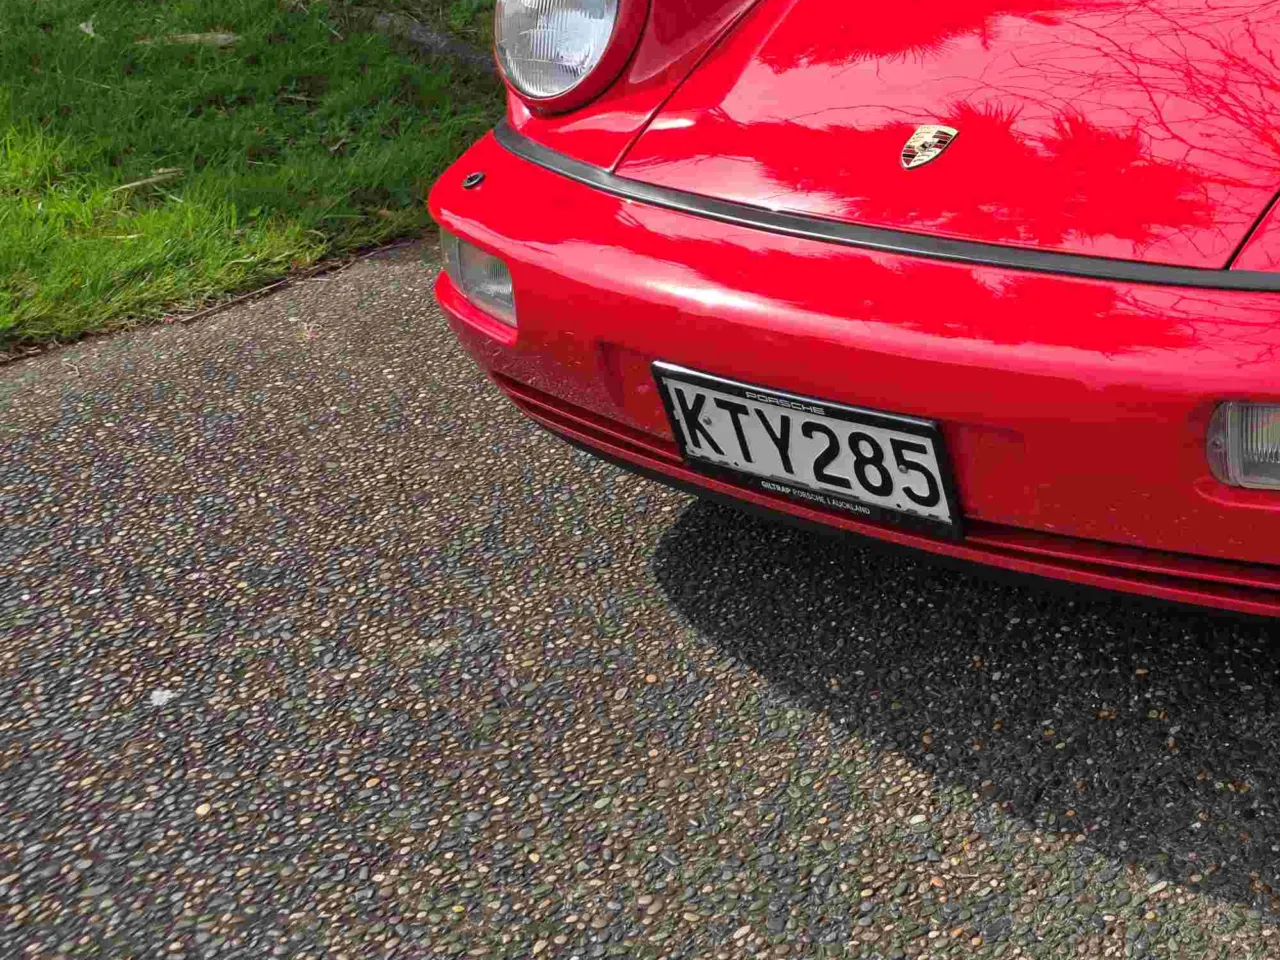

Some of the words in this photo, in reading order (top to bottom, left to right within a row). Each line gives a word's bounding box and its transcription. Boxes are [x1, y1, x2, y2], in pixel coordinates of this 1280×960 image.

[745, 391, 825, 415] PORSCHE
[674, 387, 941, 508] KTY285
[760, 480, 791, 494] GILTRAP
[792, 488, 826, 503] PORSCHE
[832, 498, 871, 515] AUCKLAND
